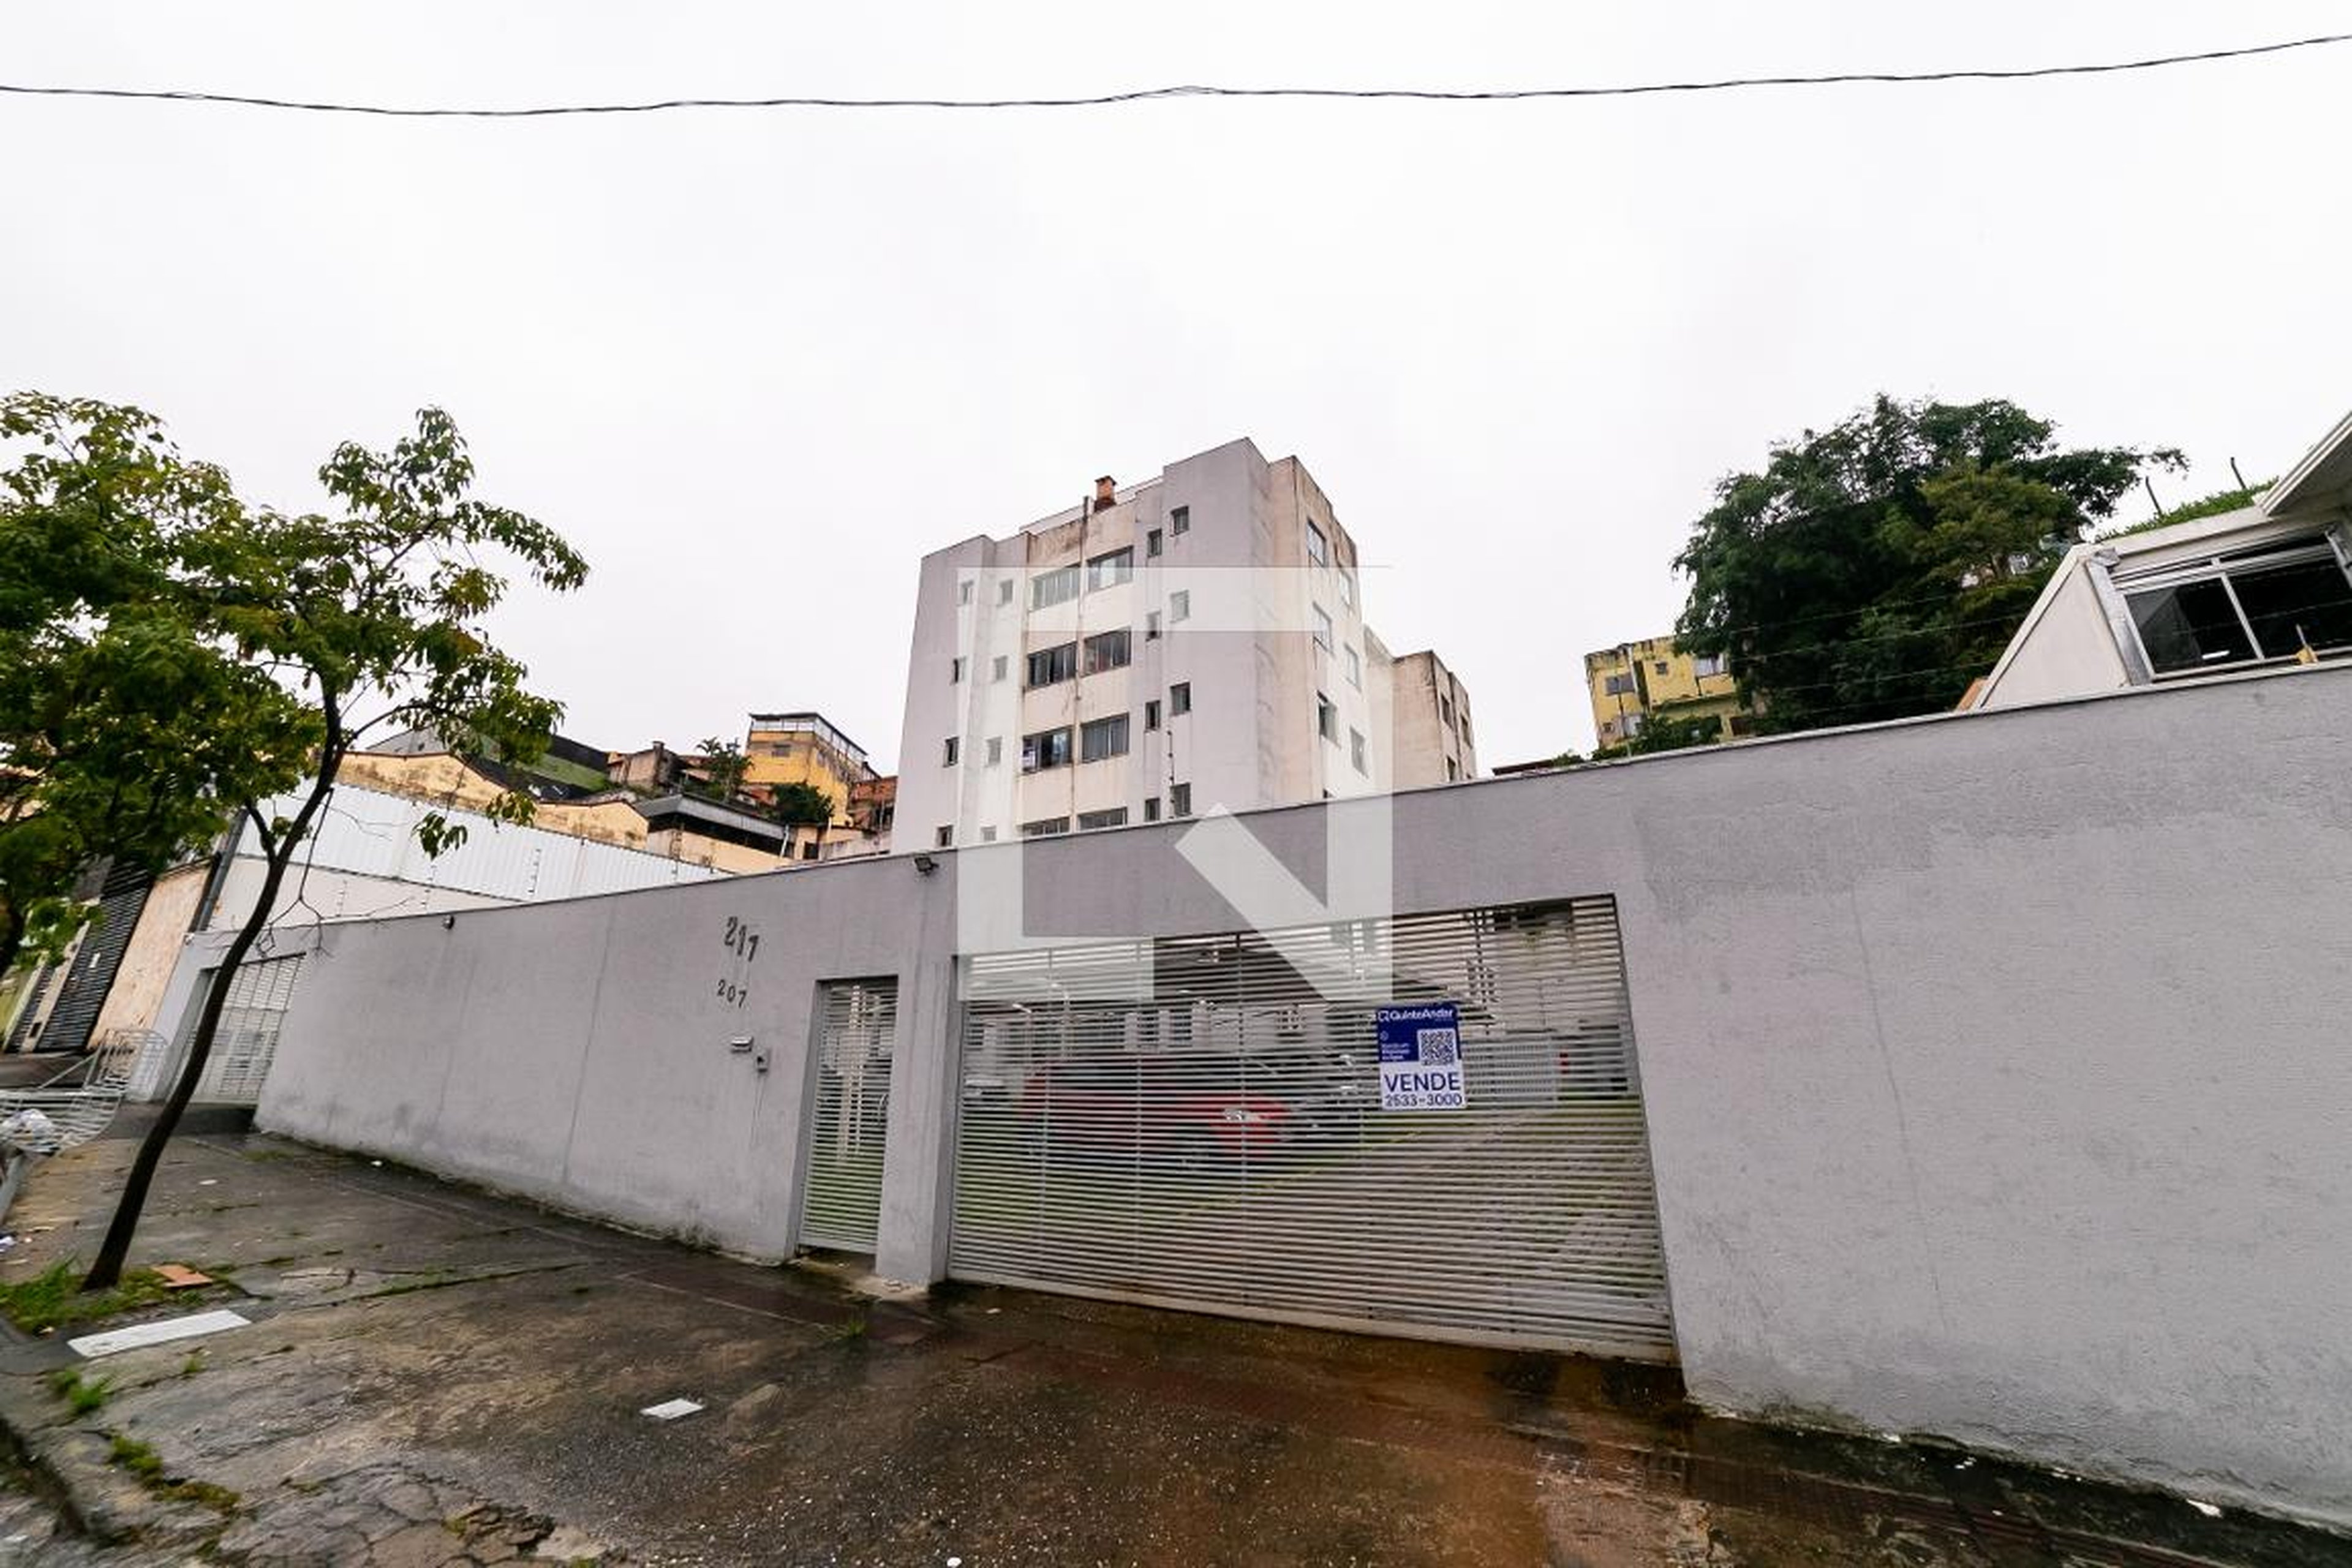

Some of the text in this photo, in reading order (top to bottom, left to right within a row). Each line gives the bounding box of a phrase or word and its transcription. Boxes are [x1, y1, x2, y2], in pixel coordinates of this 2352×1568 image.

[724, 916, 760, 963] 217
[717, 979, 747, 1009] 207
[1384, 1072, 1460, 1092] VENDE
[1385, 1093, 1462, 1107] 2533-3000
